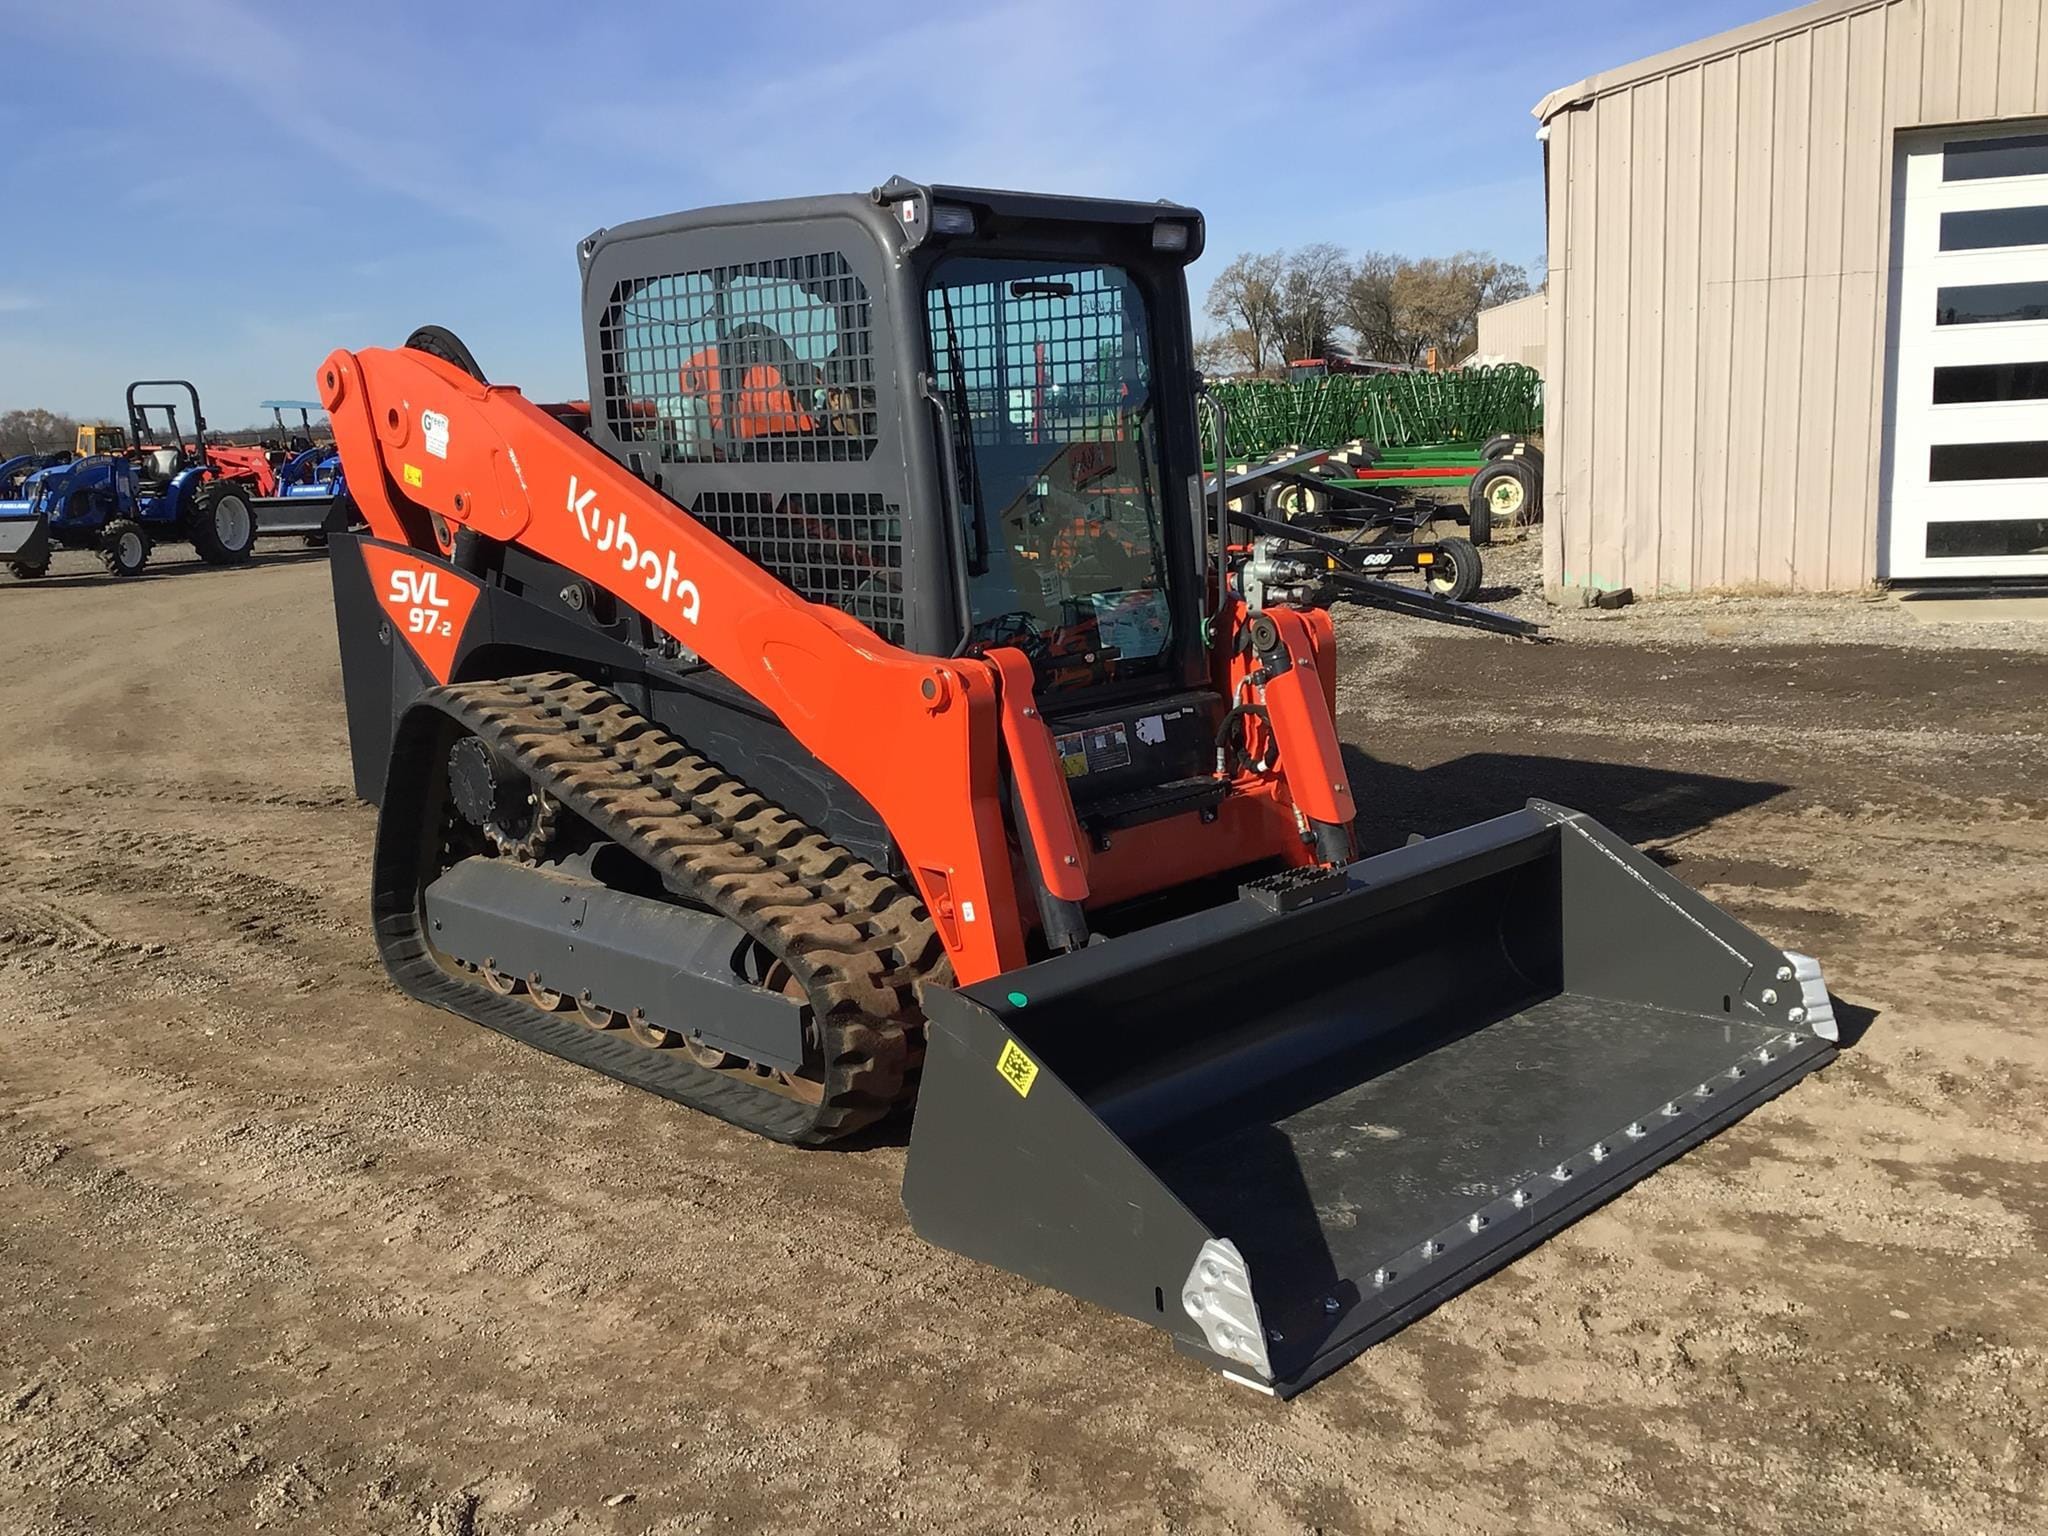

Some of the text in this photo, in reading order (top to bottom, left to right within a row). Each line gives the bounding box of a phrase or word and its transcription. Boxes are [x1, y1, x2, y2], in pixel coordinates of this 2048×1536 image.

[566, 474, 700, 625] Kubota
[1362, 553, 1393, 566] 680
[389, 569, 449, 607] SVL
[409, 607, 452, 637] 97-2
